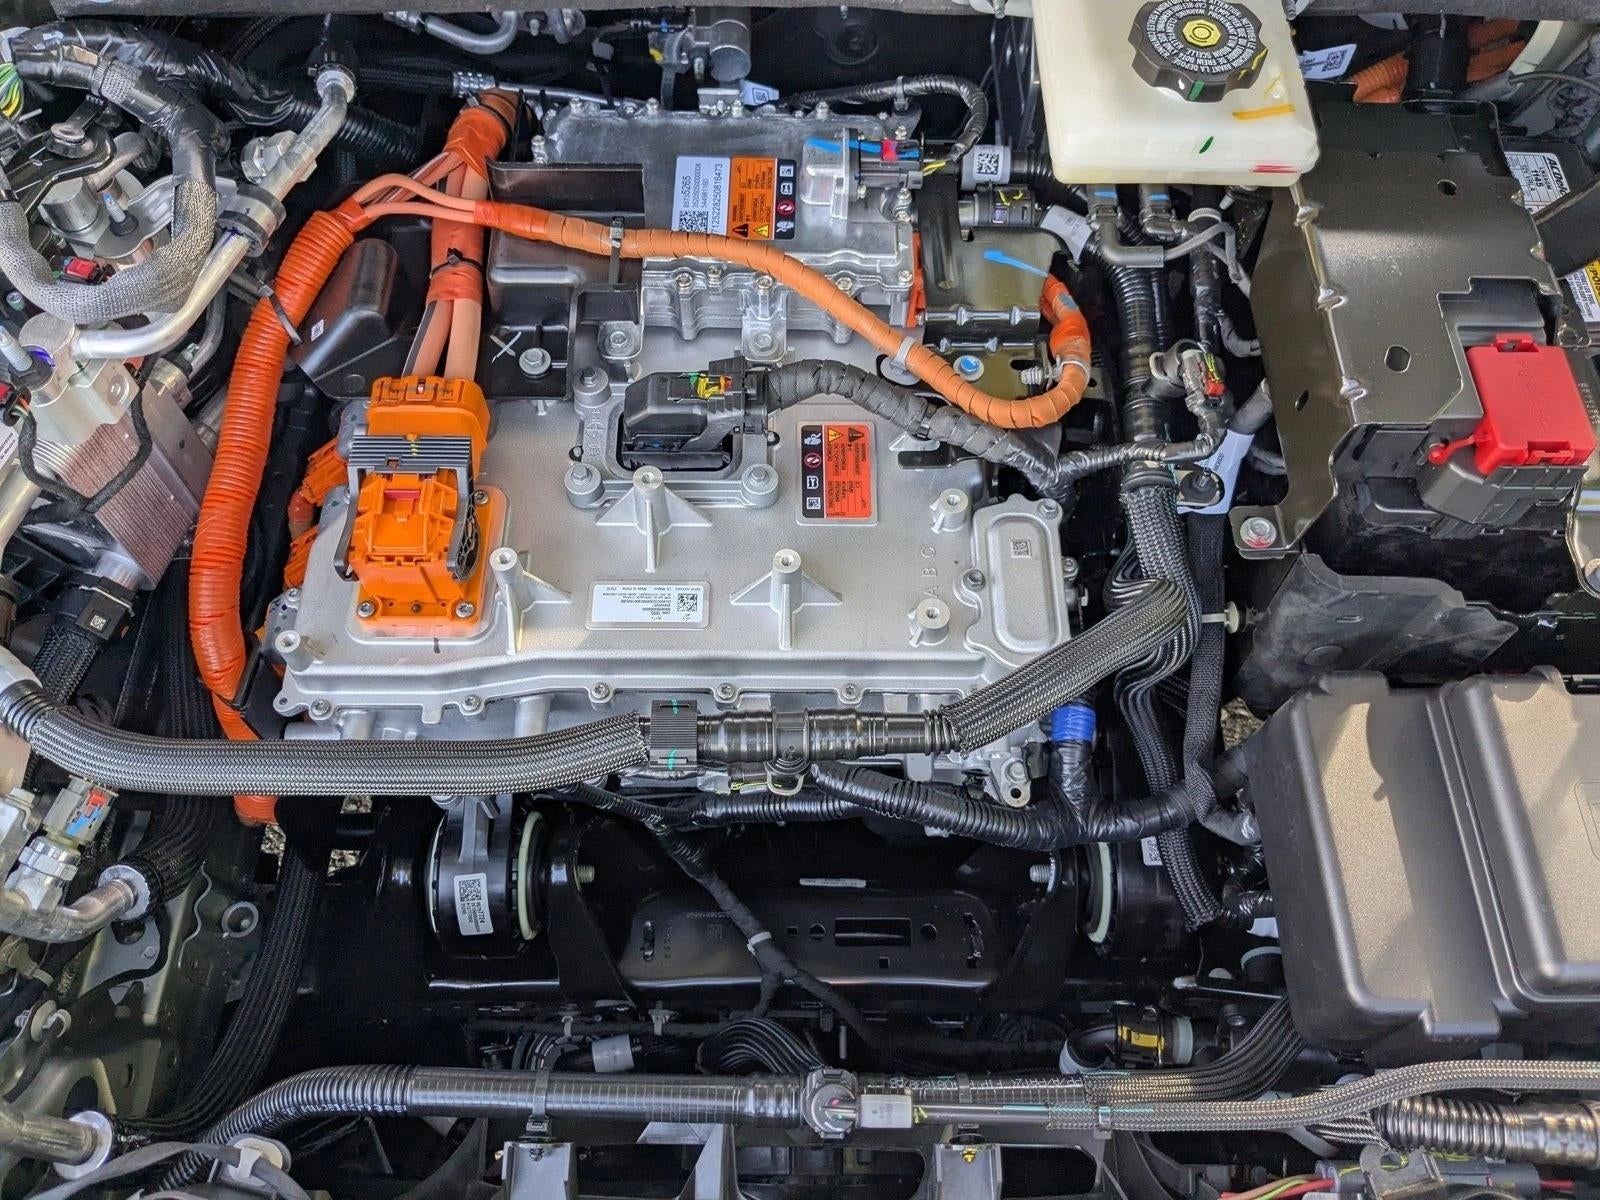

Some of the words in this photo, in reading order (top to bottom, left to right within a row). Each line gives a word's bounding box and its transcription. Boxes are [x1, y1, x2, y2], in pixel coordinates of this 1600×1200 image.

[1236, 27, 1245, 37] QUE
[1162, 42, 1178, 55] ONLY
[1212, 46, 1232, 57] BIDON
[1246, 41, 1257, 49] LE
[1224, 45, 1245, 61] LIQUIDE
[1230, 48, 1254, 68] BOUCHON
[1216, 56, 1227, 64] DE
[1211, 62, 1233, 73] AVANT
[1531, 169, 1543, 187] 1145
[1547, 157, 1567, 196] ACDelc
[921, 545, 936, 558] C
[922, 567, 937, 577] B
[924, 586, 938, 599] A
